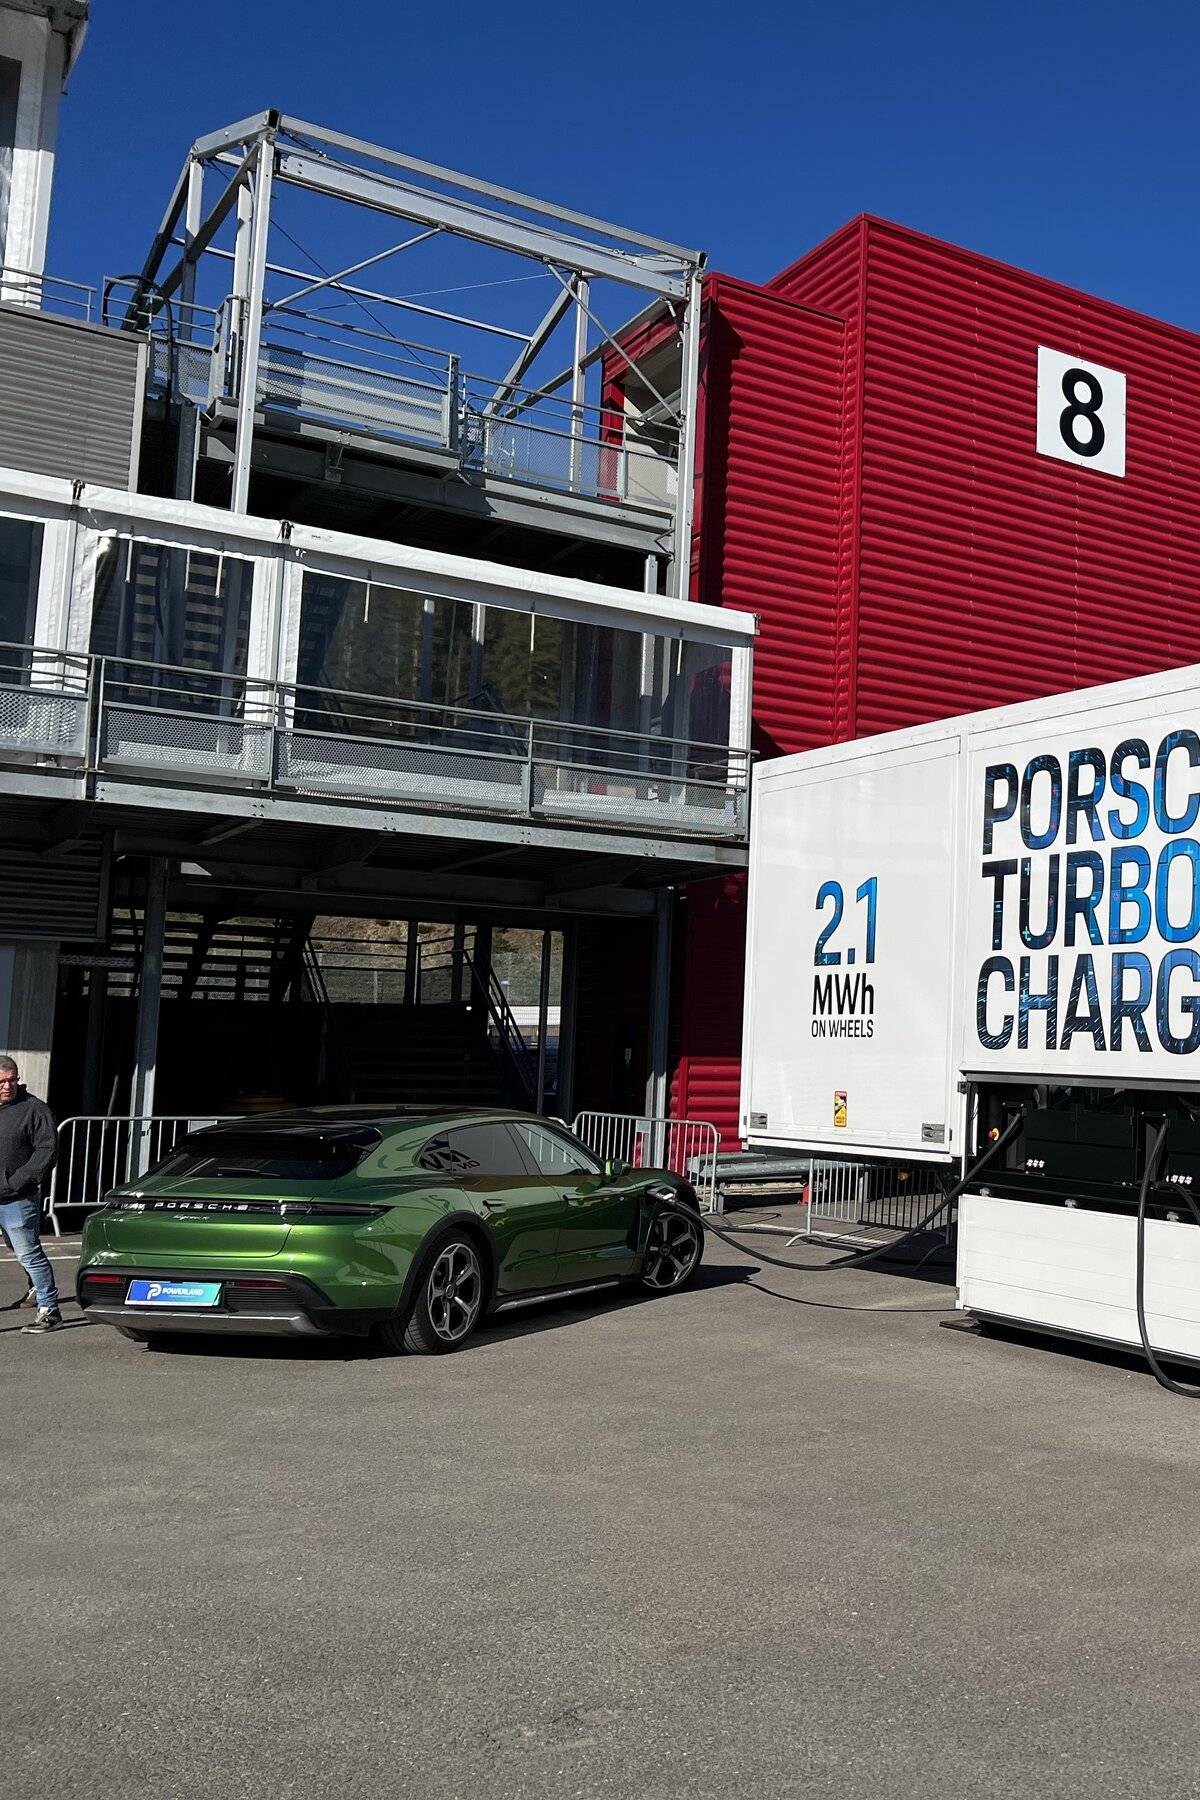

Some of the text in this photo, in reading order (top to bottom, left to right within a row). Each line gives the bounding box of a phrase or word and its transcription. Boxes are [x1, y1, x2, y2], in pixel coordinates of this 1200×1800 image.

[1060, 368, 1105, 457] 8
[814, 876, 878, 966] 2.1
[812, 972, 875, 1015] MWh
[811, 1019, 874, 1038] ON WHEELS
[154, 1202, 249, 1211] PORSCHE
[162, 1287, 204, 1296] POWERLAND
